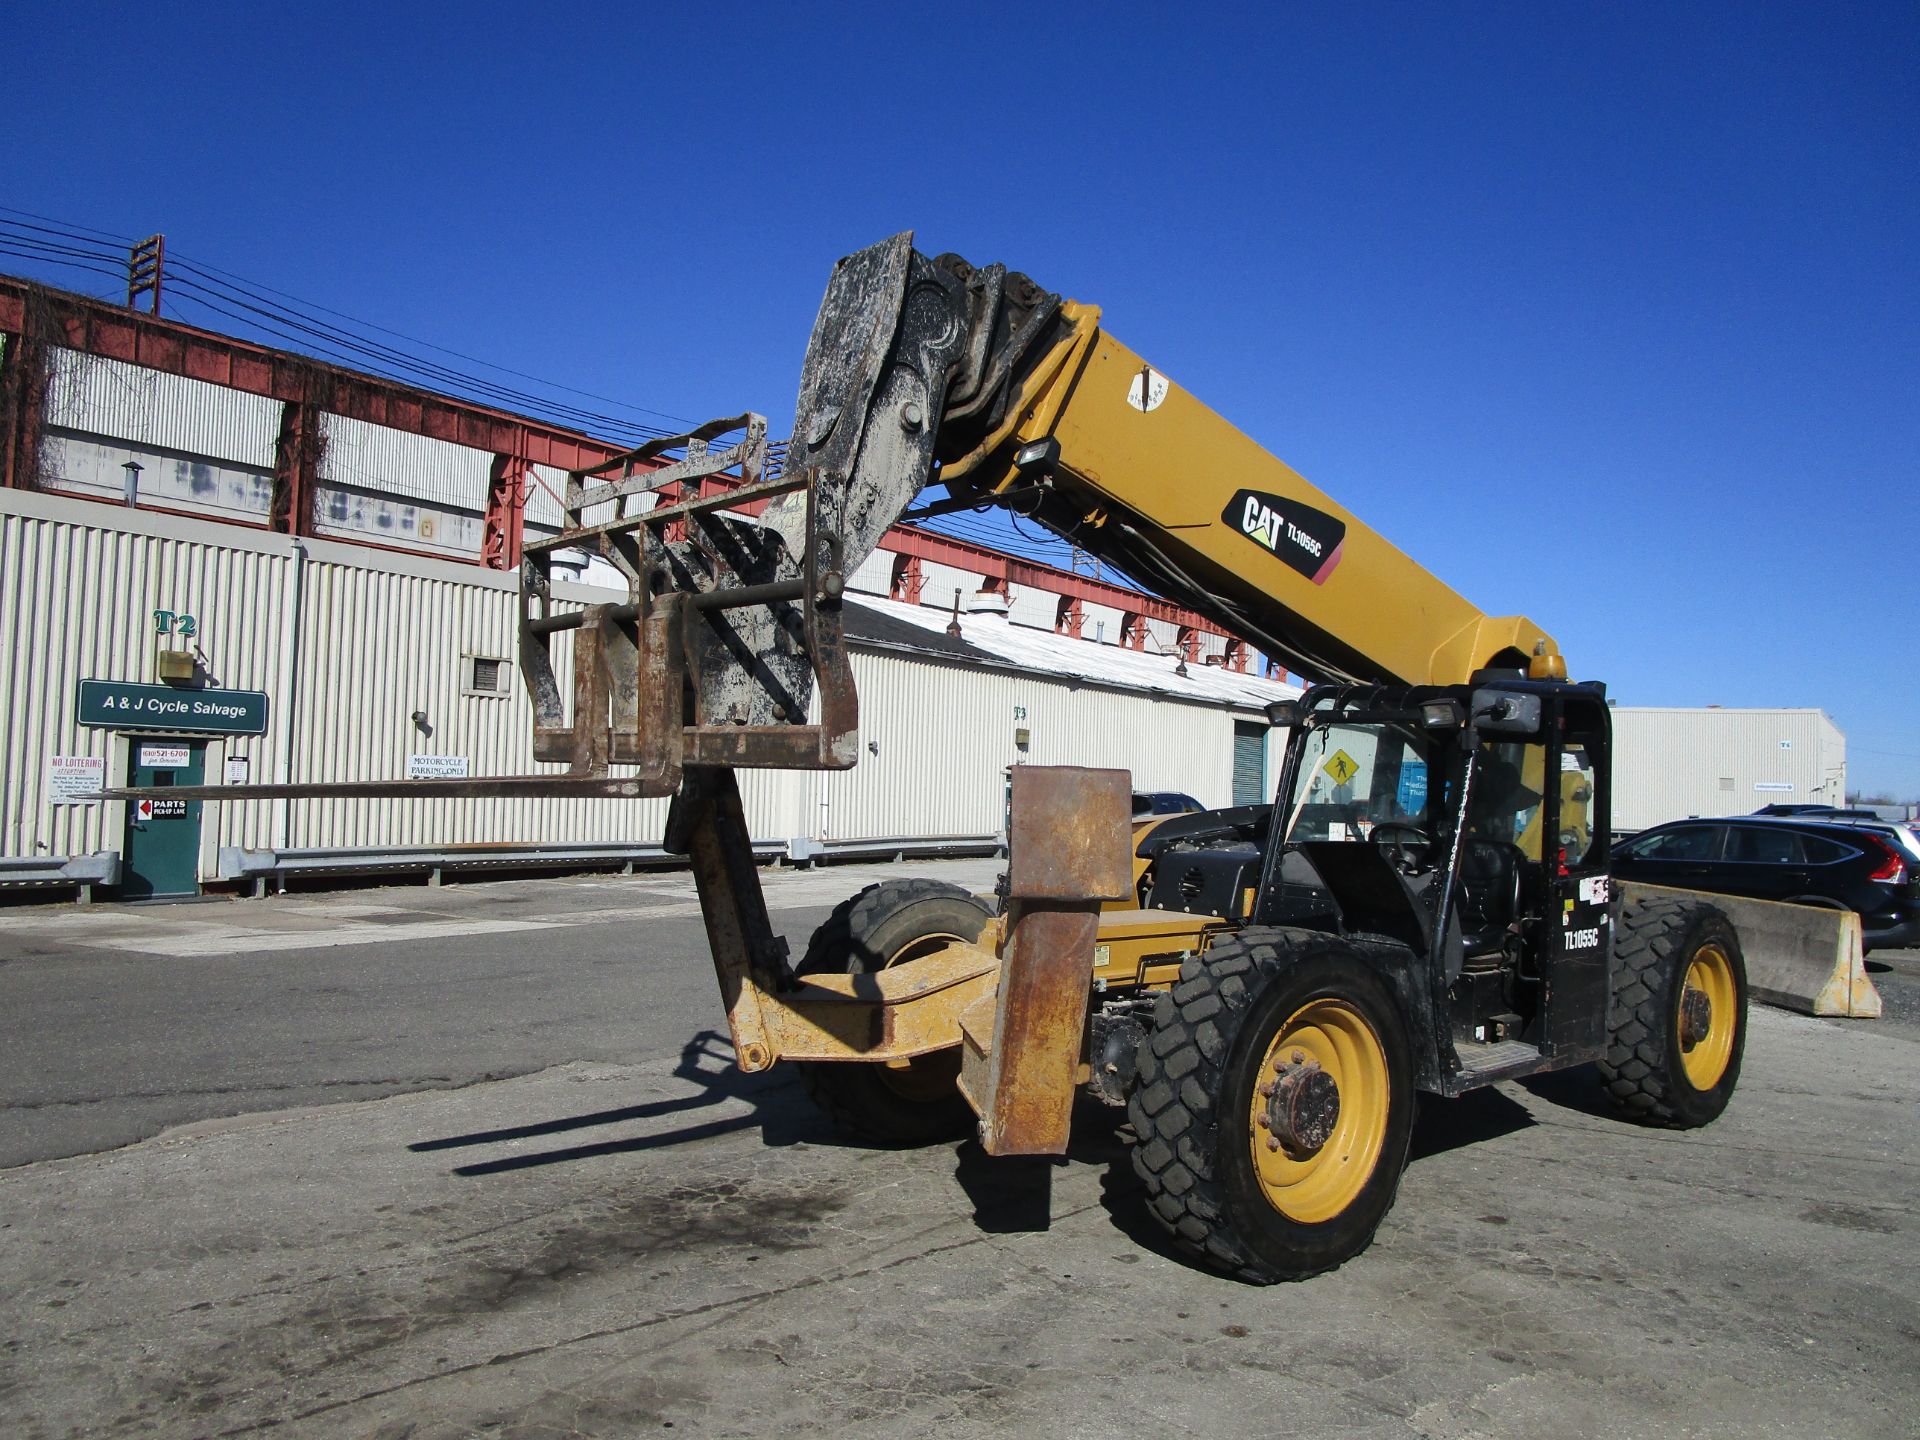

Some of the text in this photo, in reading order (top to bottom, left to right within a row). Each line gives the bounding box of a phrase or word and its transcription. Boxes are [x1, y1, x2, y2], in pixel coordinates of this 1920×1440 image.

[1242, 496, 1322, 558] CAT TL1055C
[153, 609, 198, 637] T2
[103, 695, 247, 719] A & J Cycle Salvage
[52, 758, 102, 769] NO LOITERING
[411, 766, 465, 775] PARKING ONLY
[414, 758, 463, 767] MOTORCYCLE
[1564, 927, 1598, 950] TL1055C
